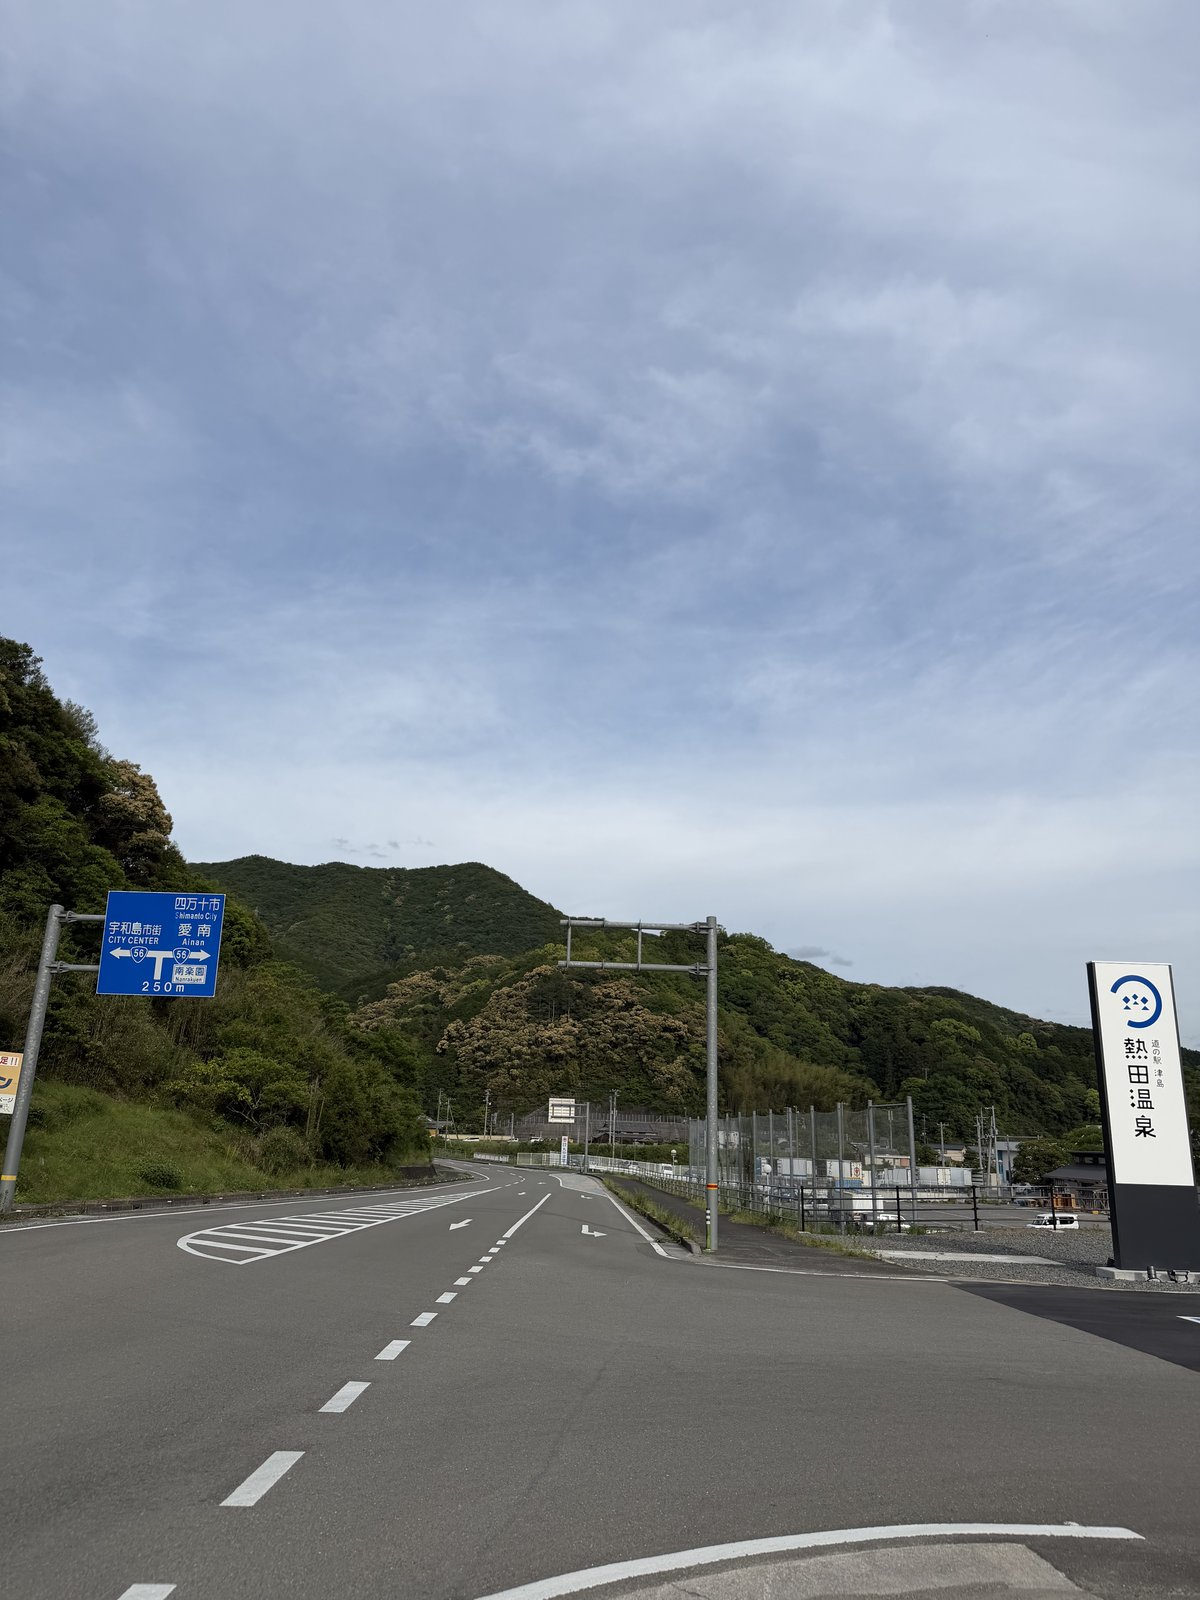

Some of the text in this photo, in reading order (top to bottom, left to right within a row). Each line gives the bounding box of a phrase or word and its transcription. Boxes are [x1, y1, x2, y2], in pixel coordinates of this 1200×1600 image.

[174, 897, 221, 911] 四万十市
[175, 912, 217, 921] Shimanto City
[109, 921, 162, 936] 宇和島市街
[108, 936, 159, 945] CITY CENTER
[182, 938, 205, 946] Ainan
[133, 949, 144, 958] 56
[176, 950, 186, 959] 56
[1151, 1039, 1164, 1088] 道の駅 津島
[1123, 1037, 1156, 1138] 熱田温泉
